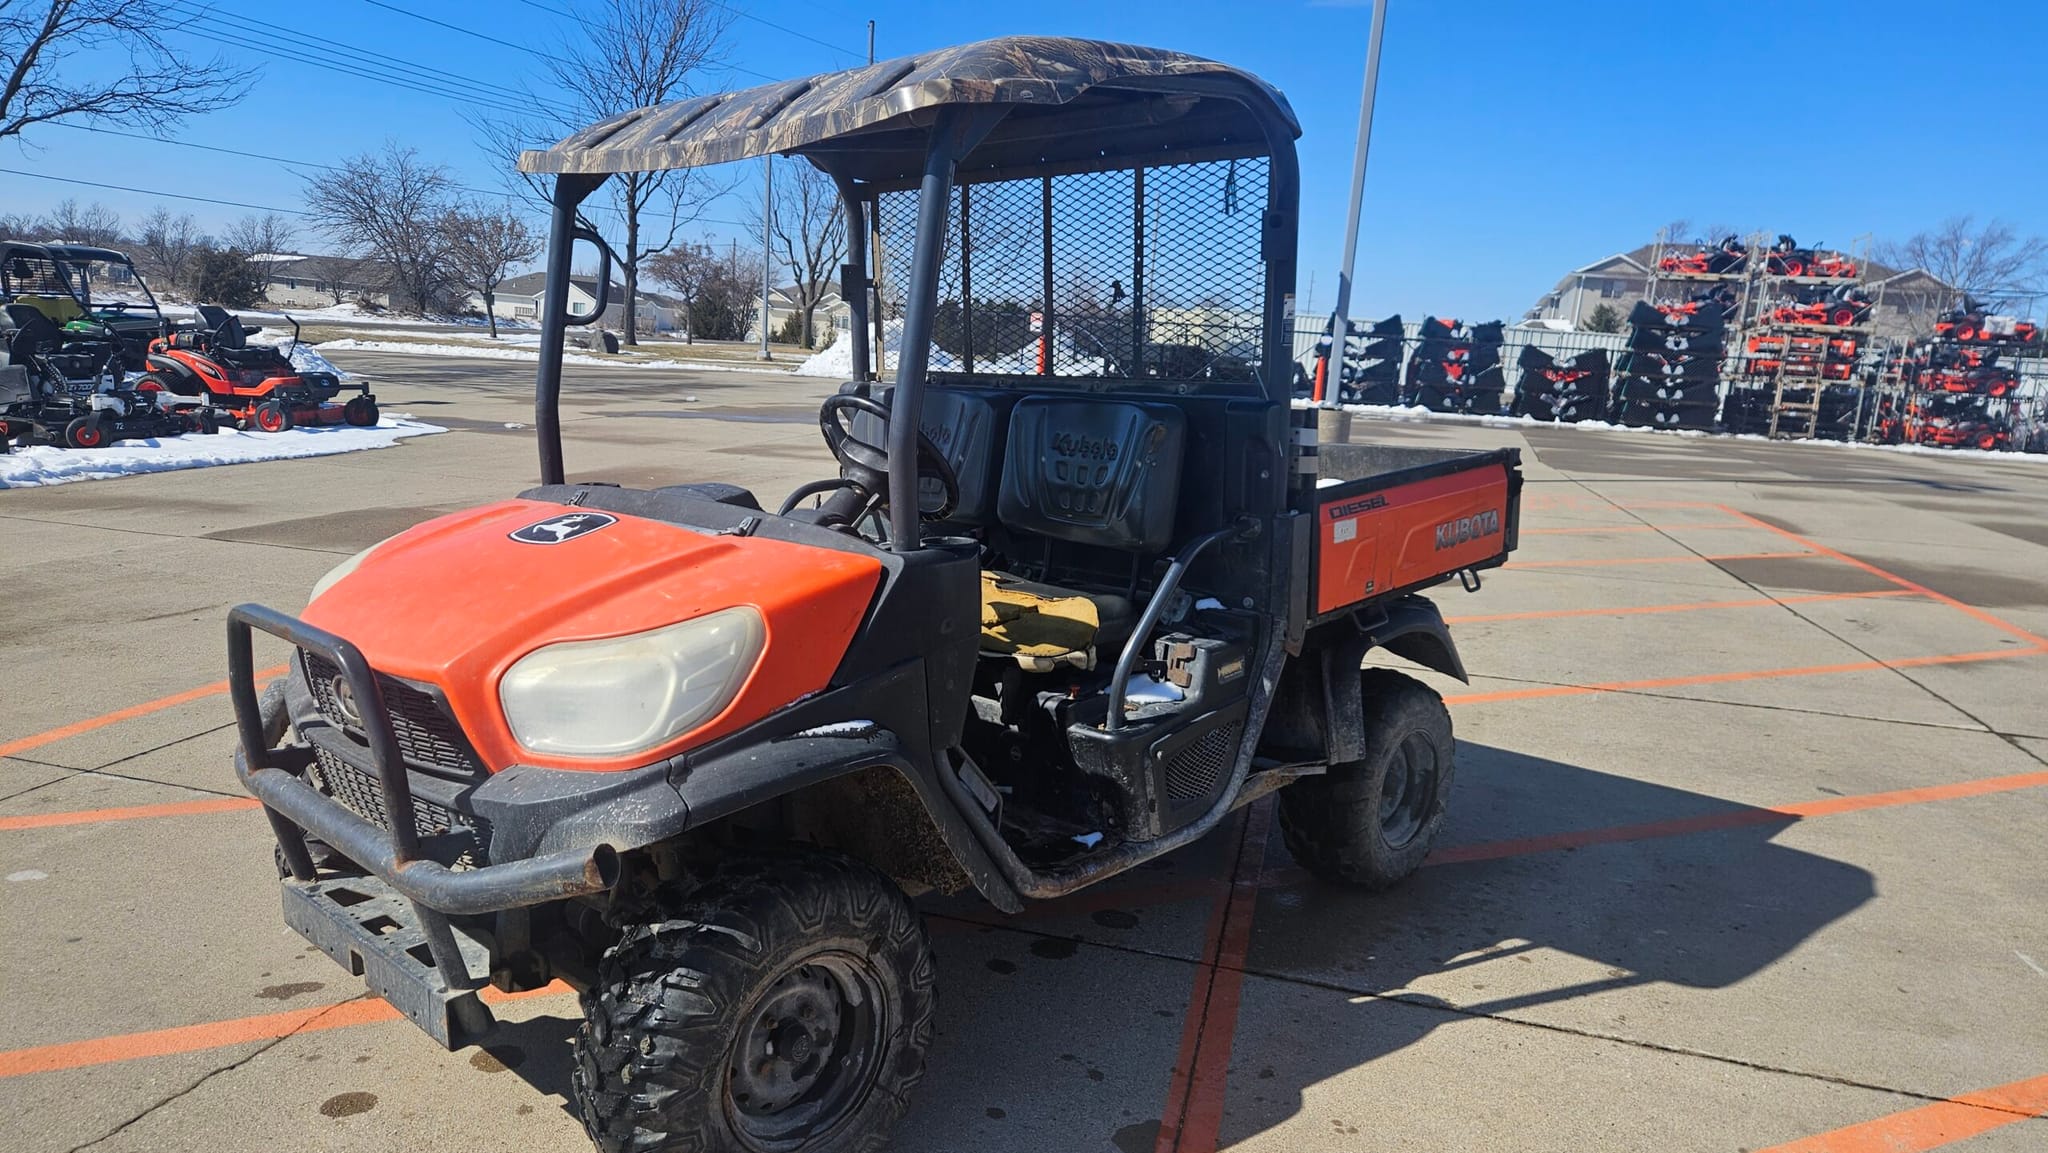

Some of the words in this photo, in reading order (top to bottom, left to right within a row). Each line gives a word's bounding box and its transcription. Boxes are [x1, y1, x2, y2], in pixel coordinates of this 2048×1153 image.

[1051, 431, 1118, 461] Kubota
[1329, 495, 1390, 519] DIESEL
[1435, 509, 1499, 551] KUBOTA
